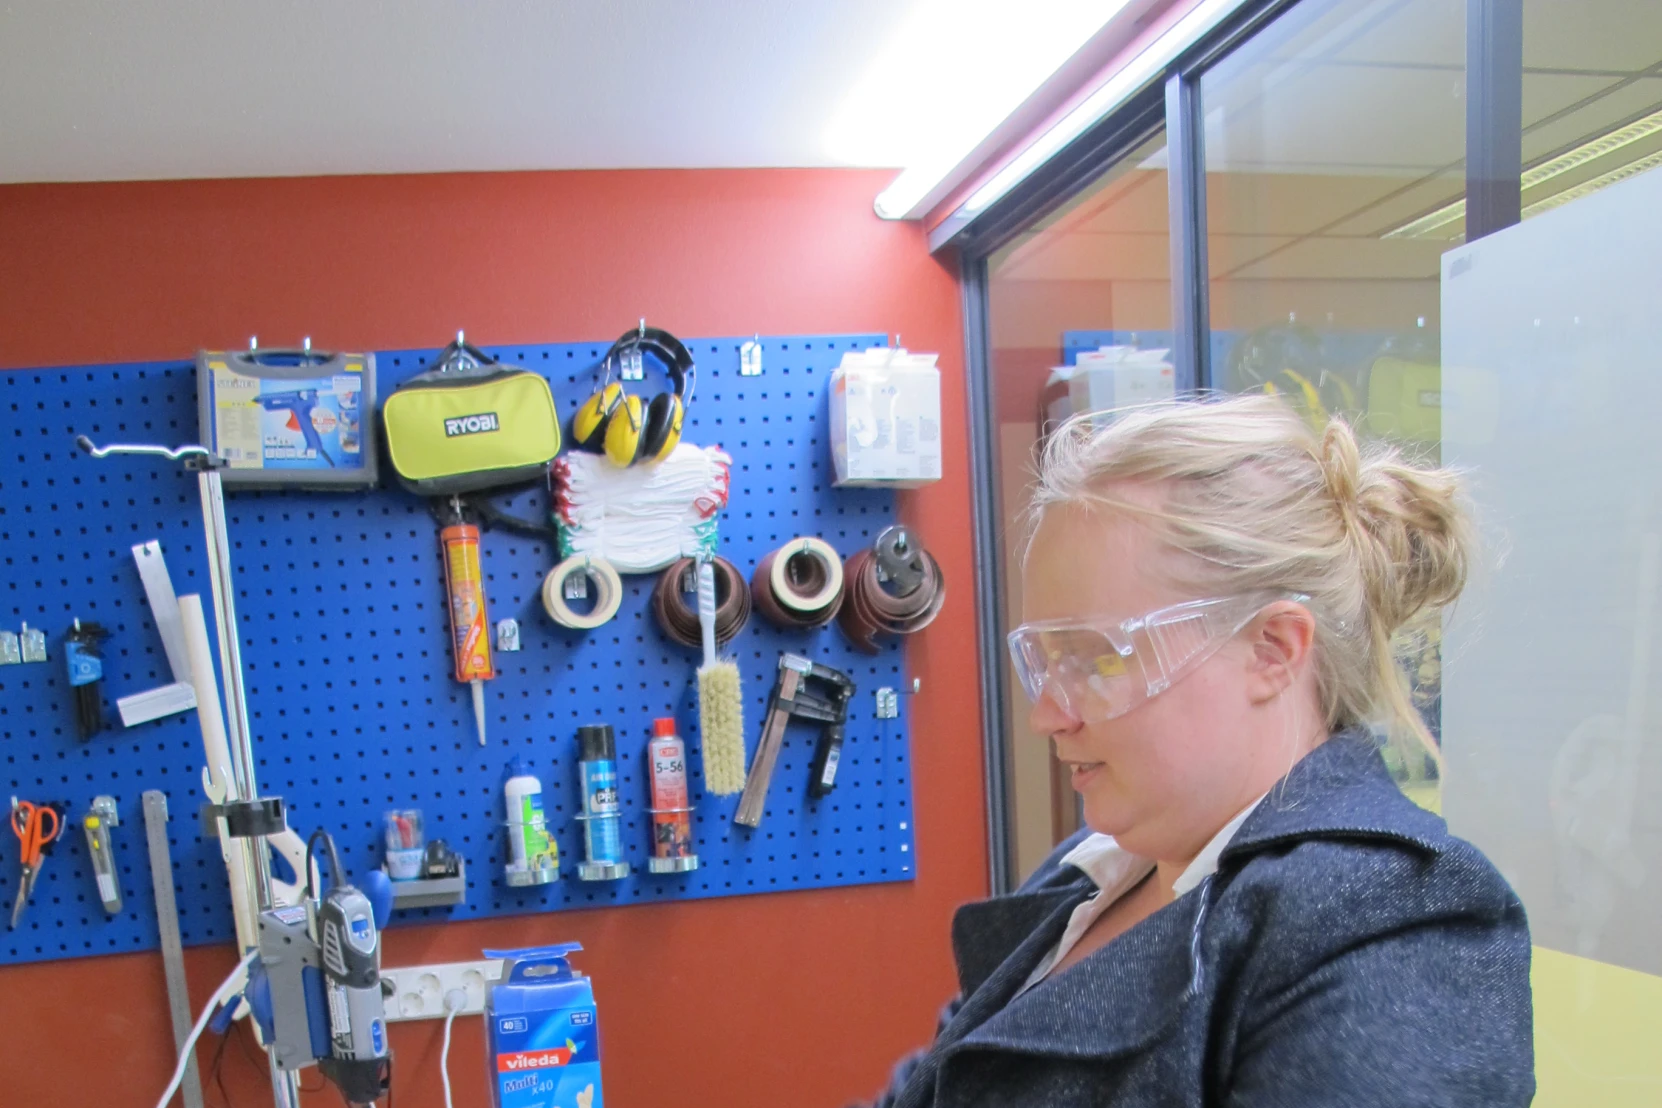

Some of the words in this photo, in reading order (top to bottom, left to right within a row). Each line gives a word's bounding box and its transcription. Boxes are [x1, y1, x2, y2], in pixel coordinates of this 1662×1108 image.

[445, 414, 496, 435] RYOBI
[656, 760, 683, 773] 5-56
[506, 1054, 560, 1069] vileda
[504, 1072, 539, 1093] Multi
[532, 1080, 554, 1095] x40
